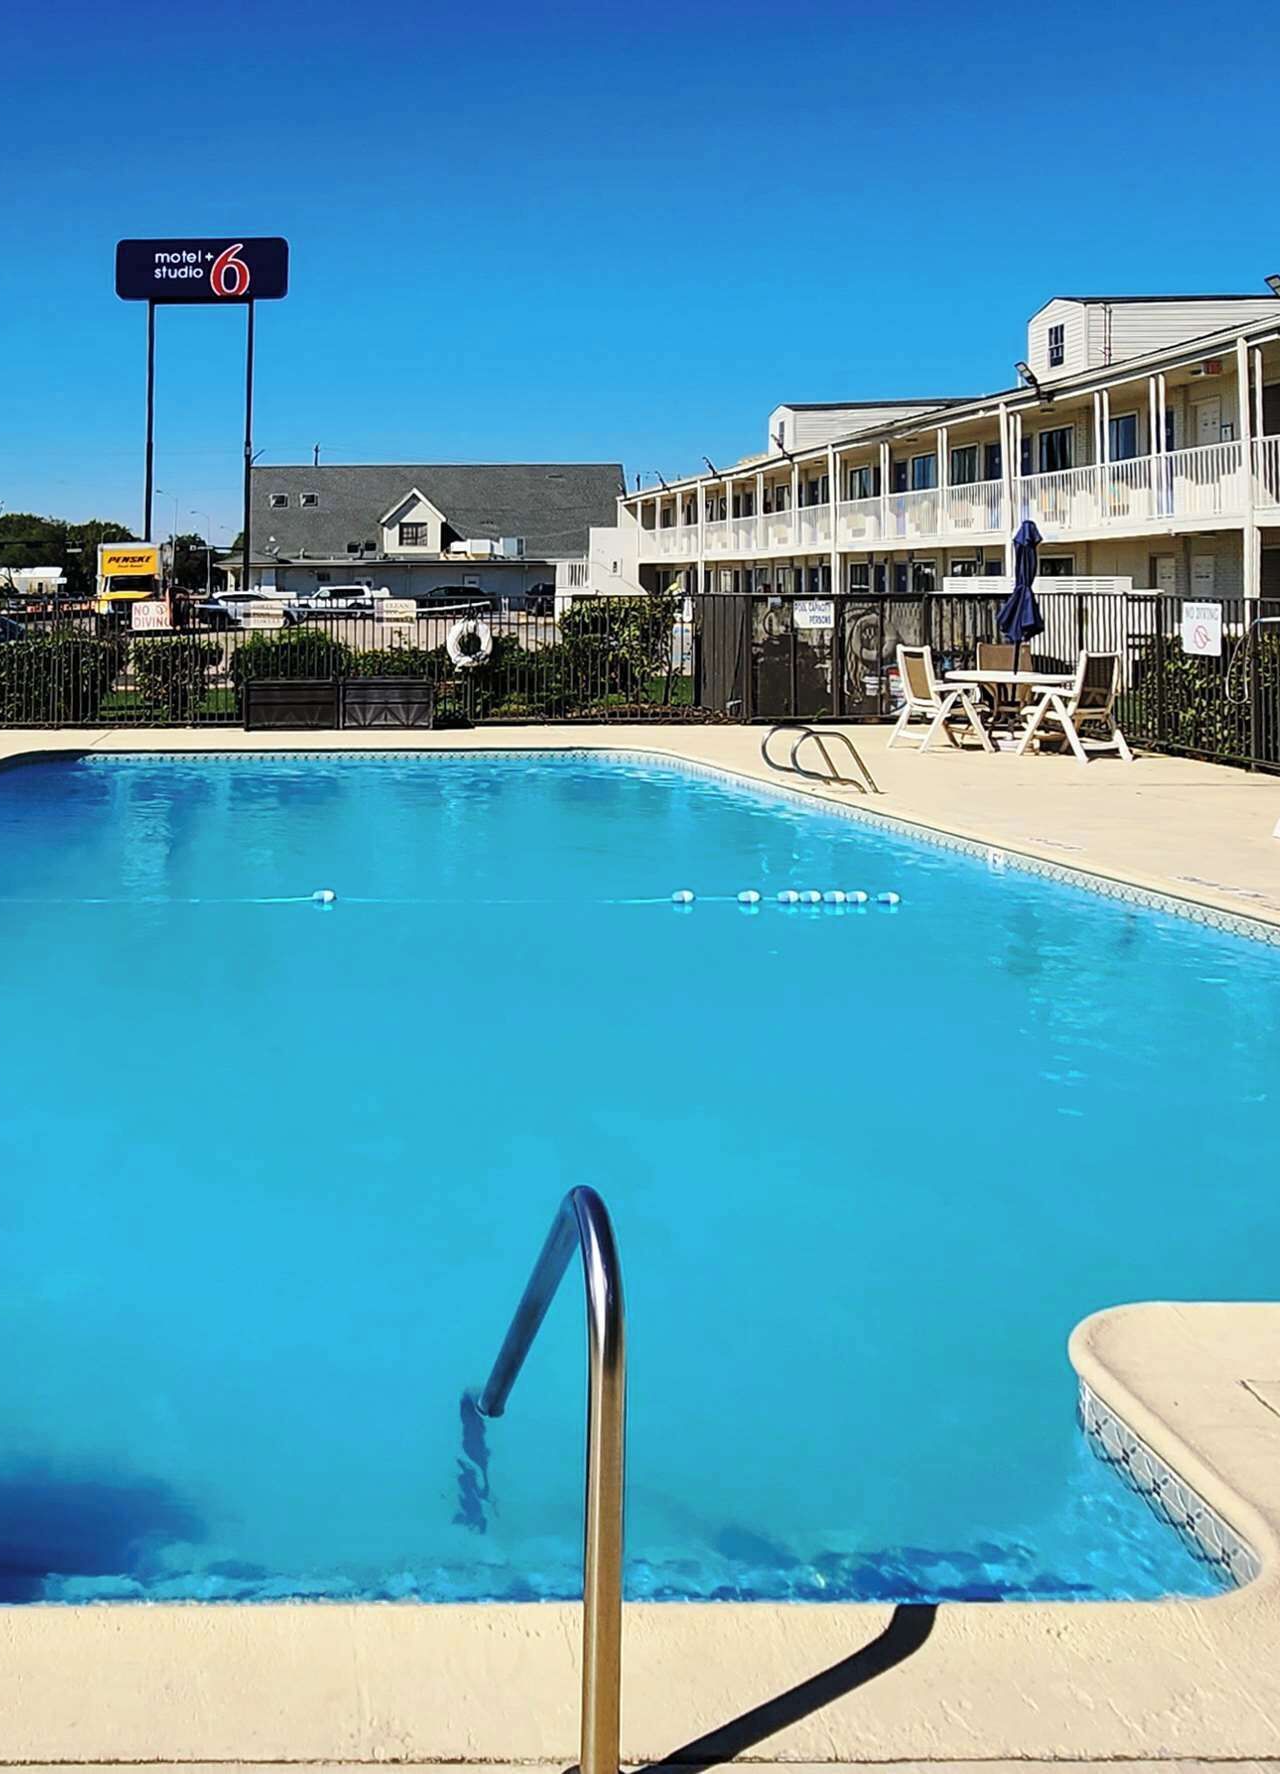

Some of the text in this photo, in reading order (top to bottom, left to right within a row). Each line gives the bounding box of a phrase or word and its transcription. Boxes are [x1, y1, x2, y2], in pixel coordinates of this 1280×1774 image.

[154, 250, 201, 263] motel
[154, 265, 204, 279] studio
[210, 243, 250, 296] 6
[107, 555, 152, 564] PENSKE
[134, 605, 149, 616] NO
